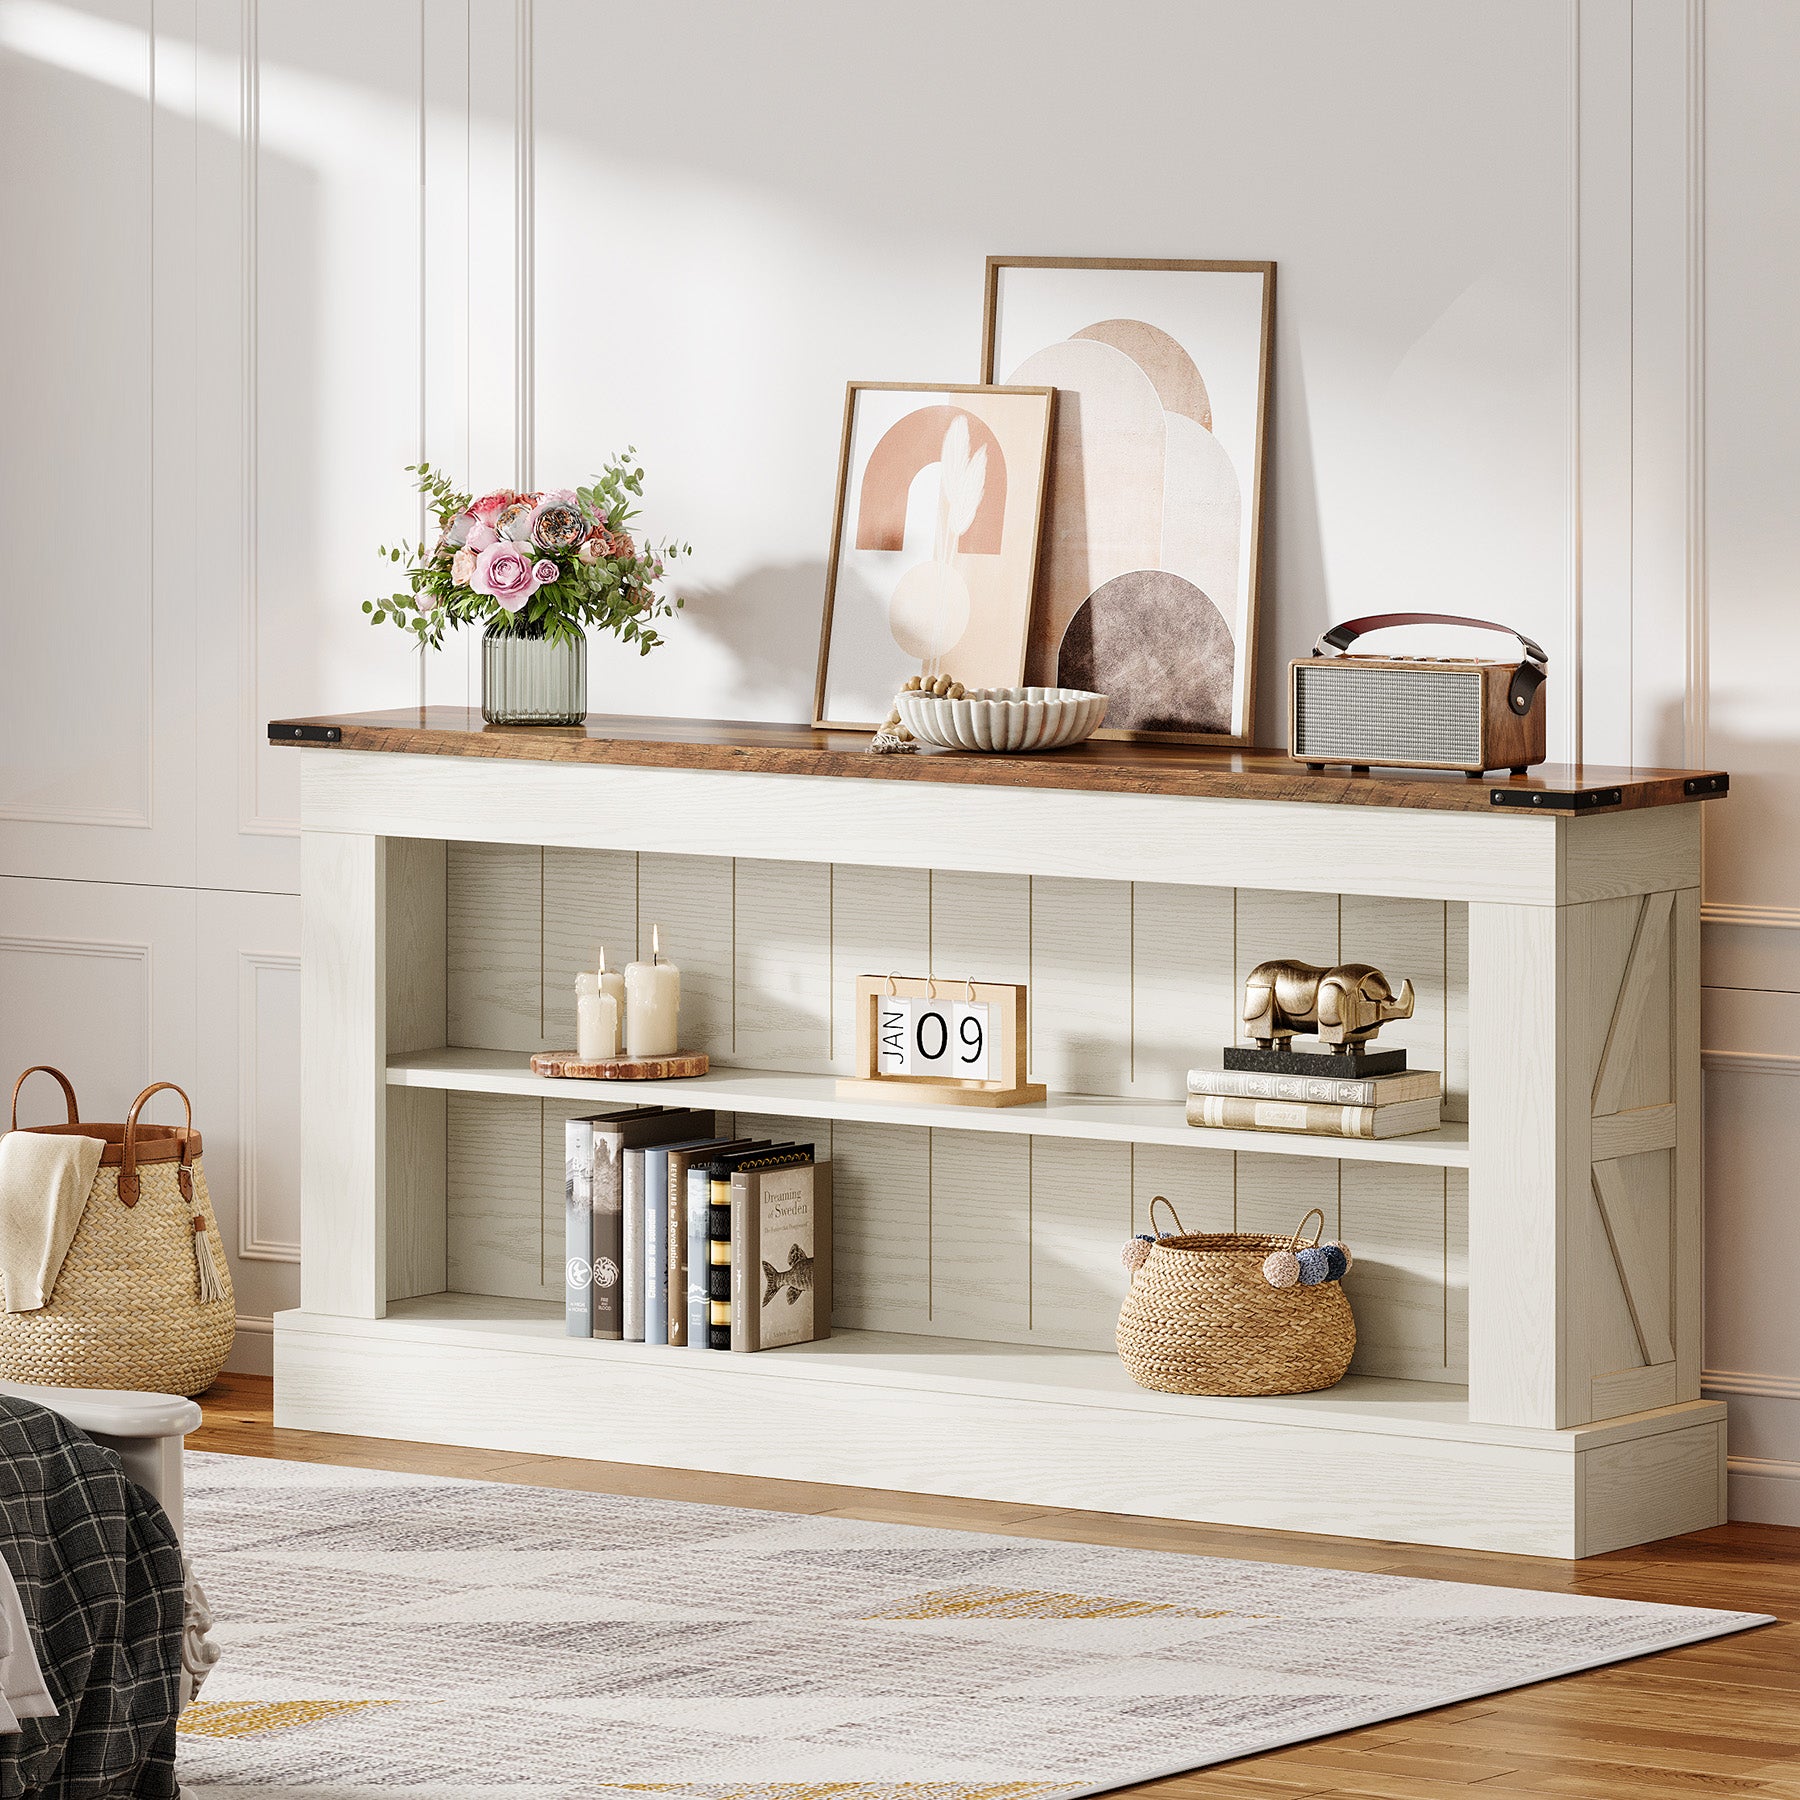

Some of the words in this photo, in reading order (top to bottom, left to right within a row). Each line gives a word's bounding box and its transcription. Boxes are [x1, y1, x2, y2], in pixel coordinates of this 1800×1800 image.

[882, 1012, 904, 1064] JAN
[917, 1012, 983, 1063] 09
[764, 1188, 802, 1203] Dreaming
[775, 1201, 808, 1218] Sweden
[670, 1220, 678, 1270] Revolution
